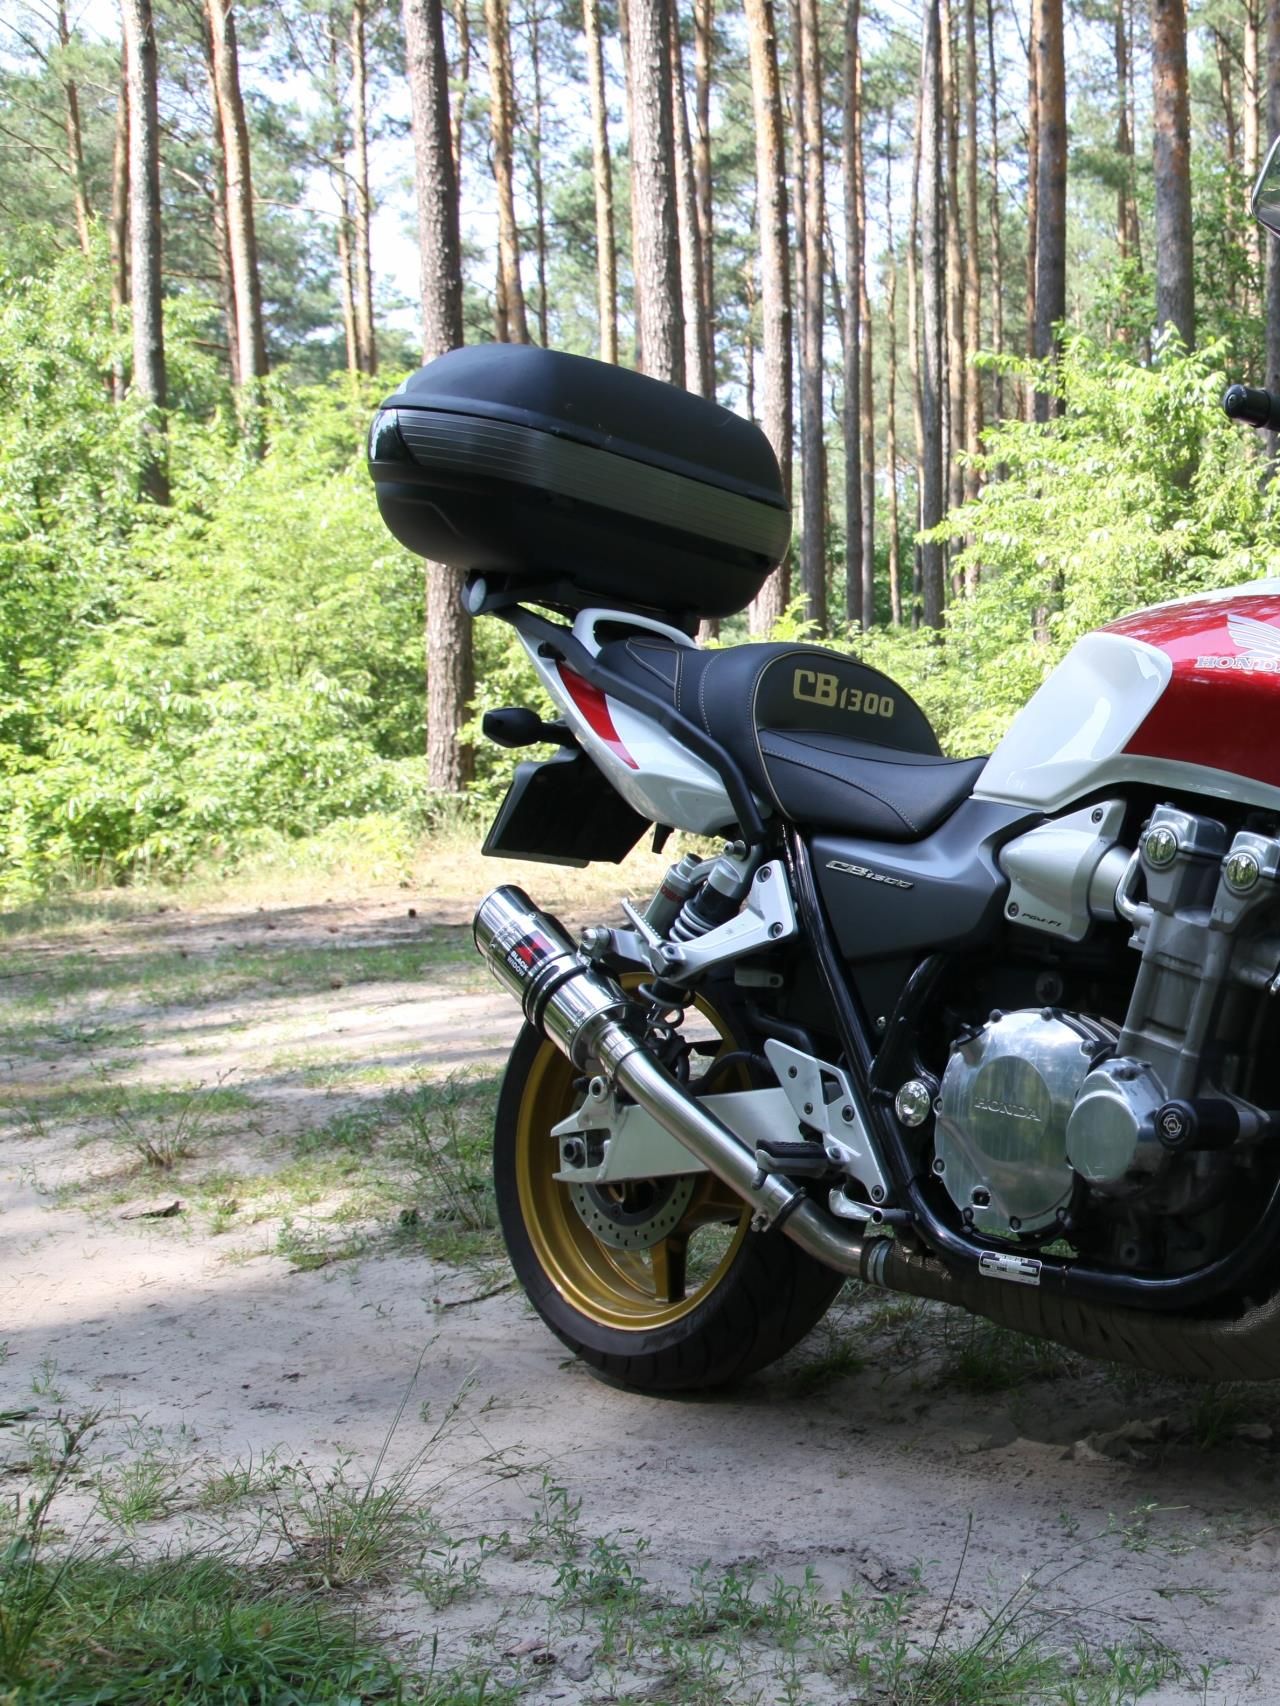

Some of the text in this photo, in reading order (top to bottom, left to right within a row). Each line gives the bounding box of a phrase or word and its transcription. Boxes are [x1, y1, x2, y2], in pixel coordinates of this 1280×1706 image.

[793, 669, 895, 718] CB1300
[510, 950, 529, 971] BLACK
[974, 1096, 1042, 1121] HONDA
